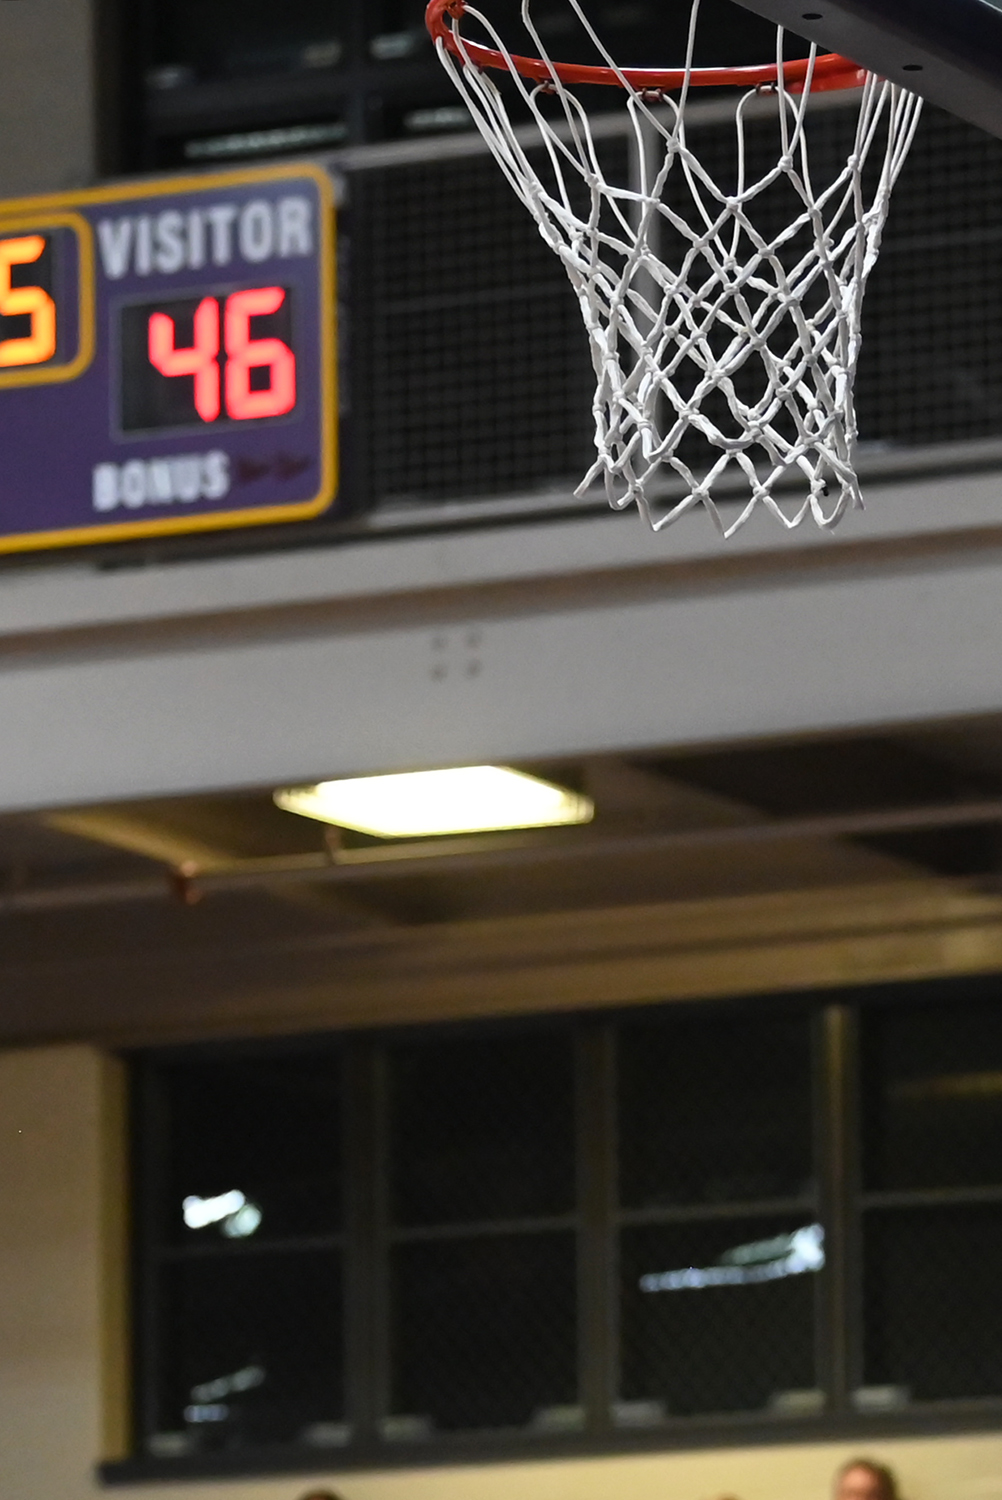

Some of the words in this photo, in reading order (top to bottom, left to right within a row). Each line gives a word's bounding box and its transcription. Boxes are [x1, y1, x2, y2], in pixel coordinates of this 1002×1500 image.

[99, 195, 314, 280] VISITOR
[148, 286, 297, 423] 46
[92, 450, 230, 512] BONUS
